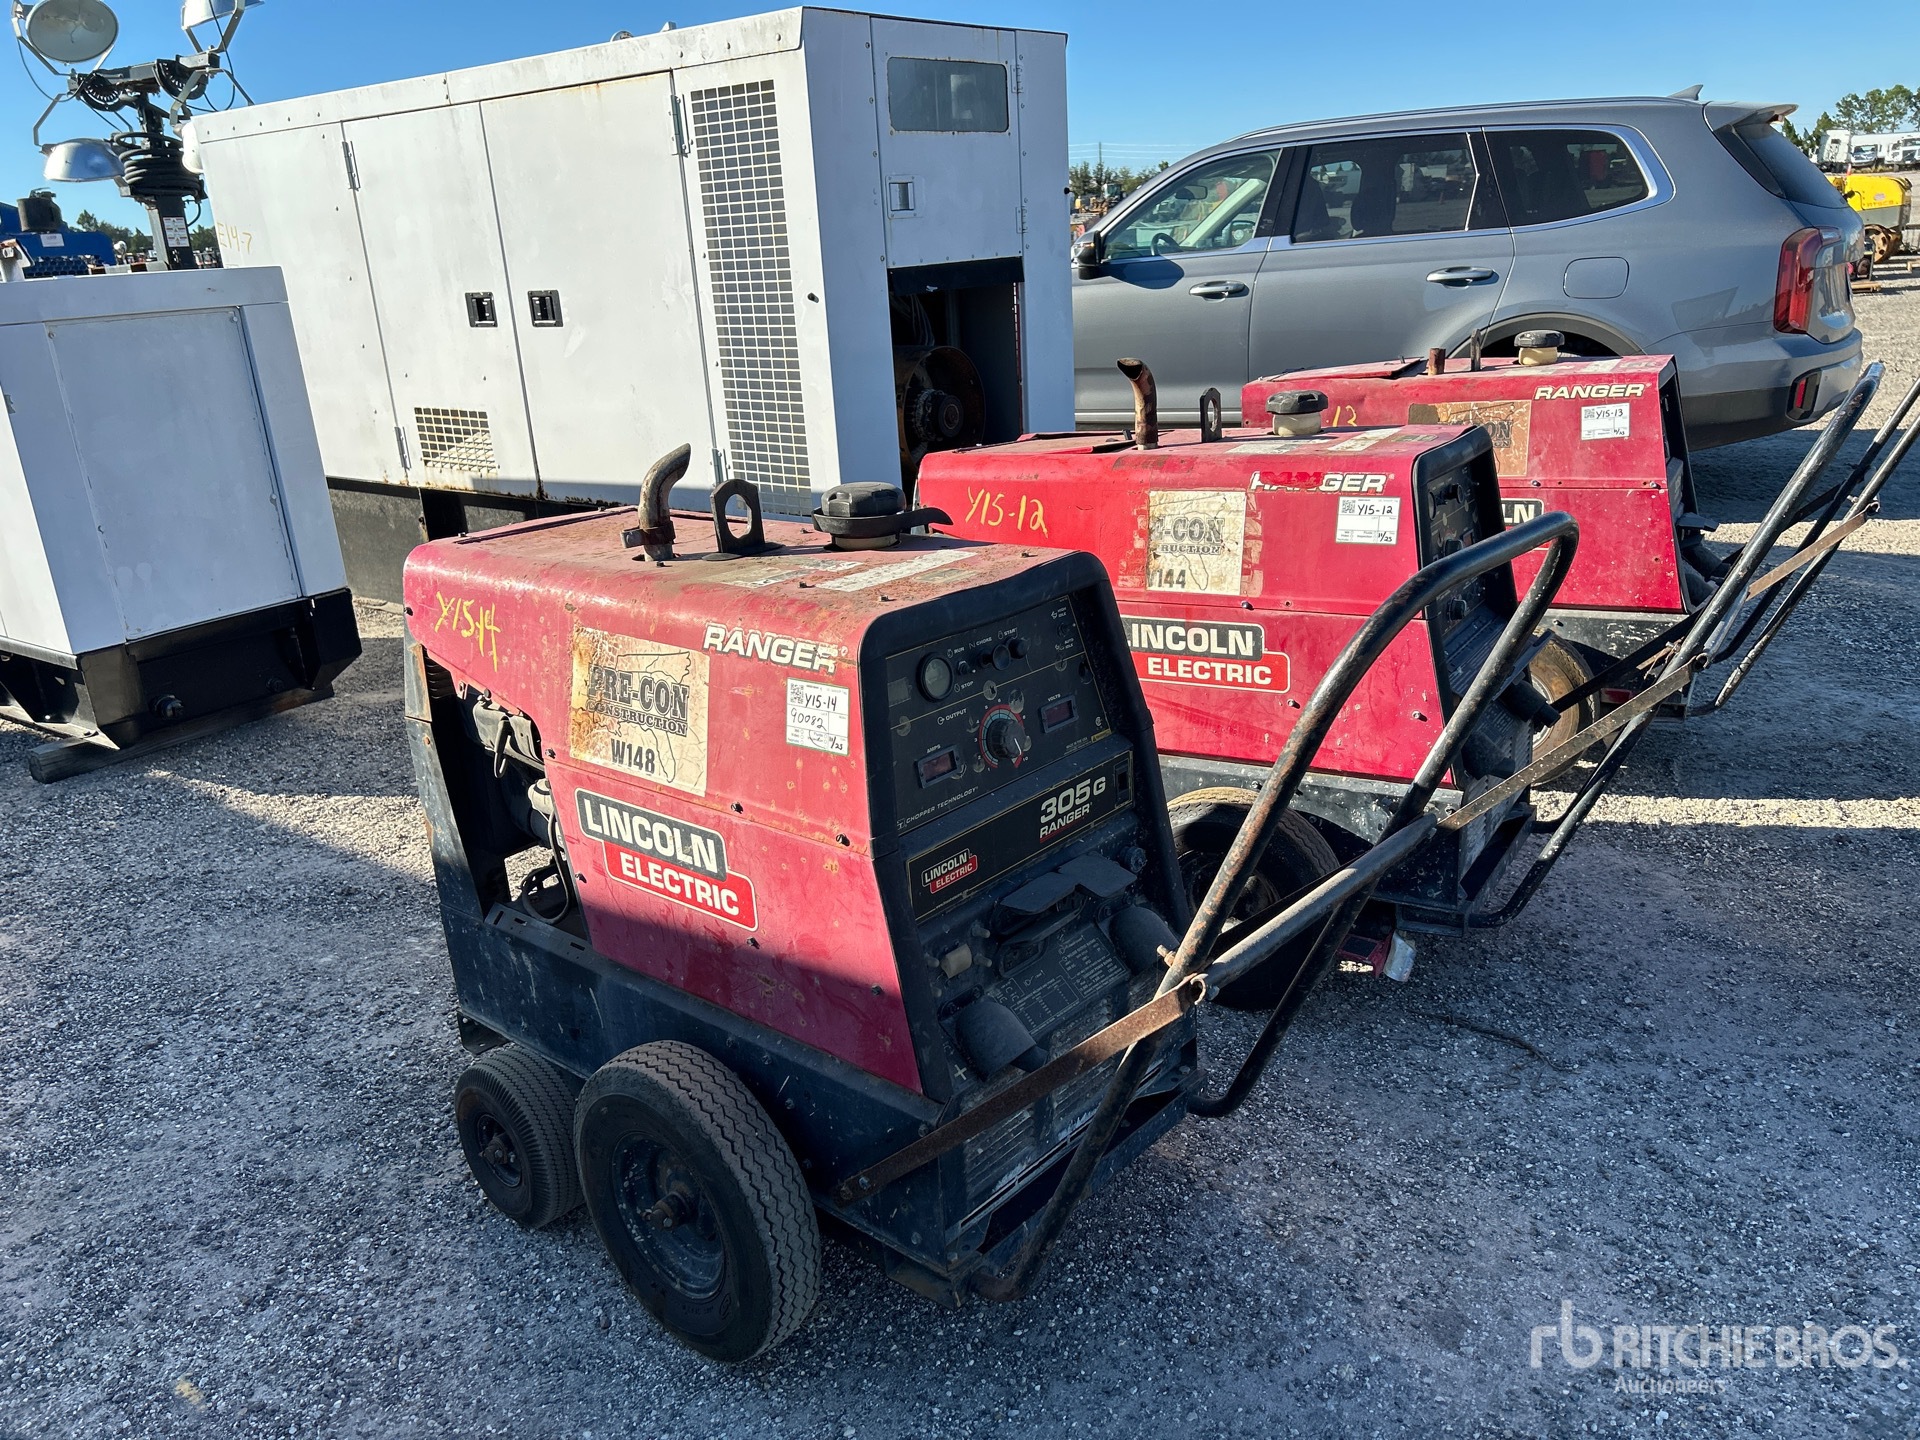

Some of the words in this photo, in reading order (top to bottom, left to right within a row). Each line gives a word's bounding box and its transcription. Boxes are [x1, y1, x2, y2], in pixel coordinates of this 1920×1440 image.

[217, 222, 252, 254] E14-7
[1534, 383, 1645, 400] RANGER
[1596, 408, 1623, 419] Y15-13
[965, 486, 1049, 539] Y15-12
[1357, 504, 1393, 515] Y15-12
[976, 636, 992, 646] CHOKE
[1004, 627, 1017, 636] START
[1126, 623, 1254, 656] INCOLN
[703, 622, 838, 675] RANGER
[953, 646, 965, 654] RUN
[1147, 656, 1272, 685] ELECTRIC
[587, 662, 690, 721] PRE-CON
[960, 681, 974, 689] STOP
[1047, 693, 1061, 702] VOLTS
[805, 693, 837, 712] Y15-14
[945, 708, 967, 721] OUTPUT
[586, 700, 688, 737] CONSTRUCTION
[791, 707, 827, 732] 90082
[610, 738, 656, 774] W148
[926, 744, 941, 753] AMPS
[906, 806, 935, 824] CHOPPER
[936, 787, 976, 809] TECHNOLOGY
[1040, 803, 1090, 838] RANGER
[583, 798, 718, 874] LINCOLN
[924, 852, 967, 883] LINCOLN
[936, 863, 973, 889] ELECTRIC
[619, 851, 740, 916] ELECTRIC
